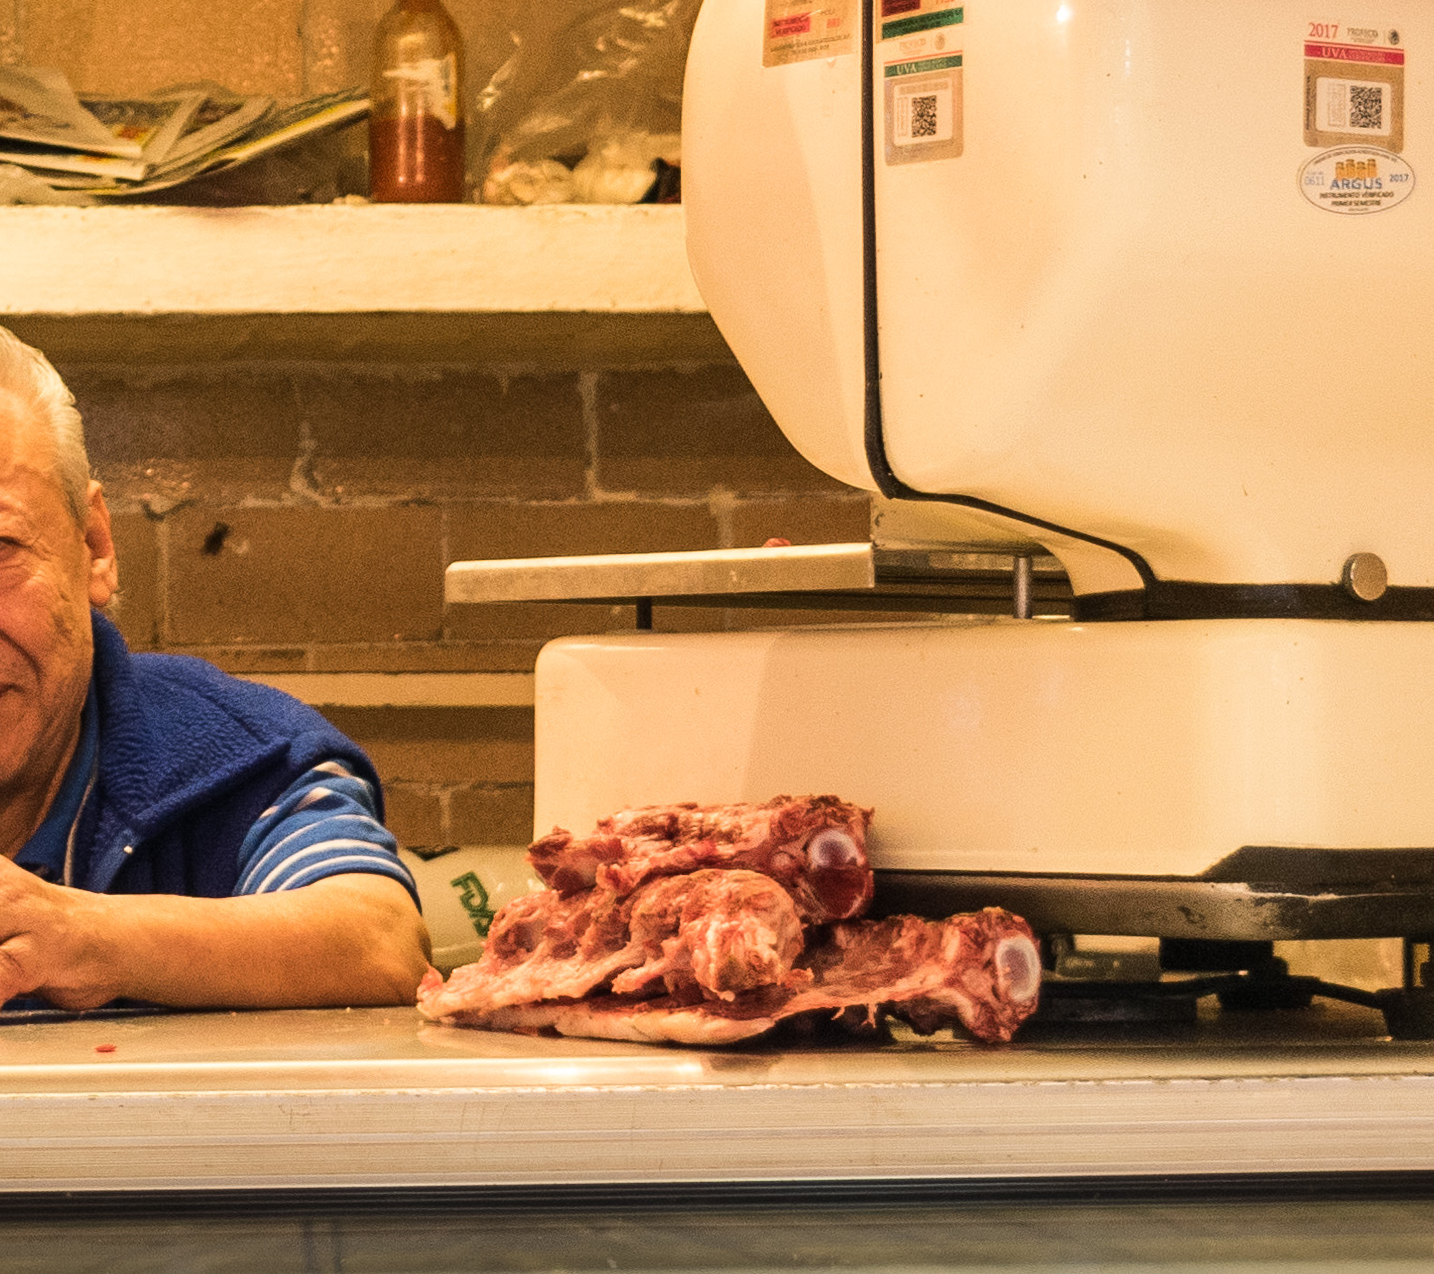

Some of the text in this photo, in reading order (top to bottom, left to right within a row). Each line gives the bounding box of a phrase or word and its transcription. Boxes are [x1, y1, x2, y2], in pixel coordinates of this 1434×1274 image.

[1308, 22, 1339, 39] 2017
[1321, 46, 1348, 59] UVA
[1330, 178, 1383, 191] ARGUS
